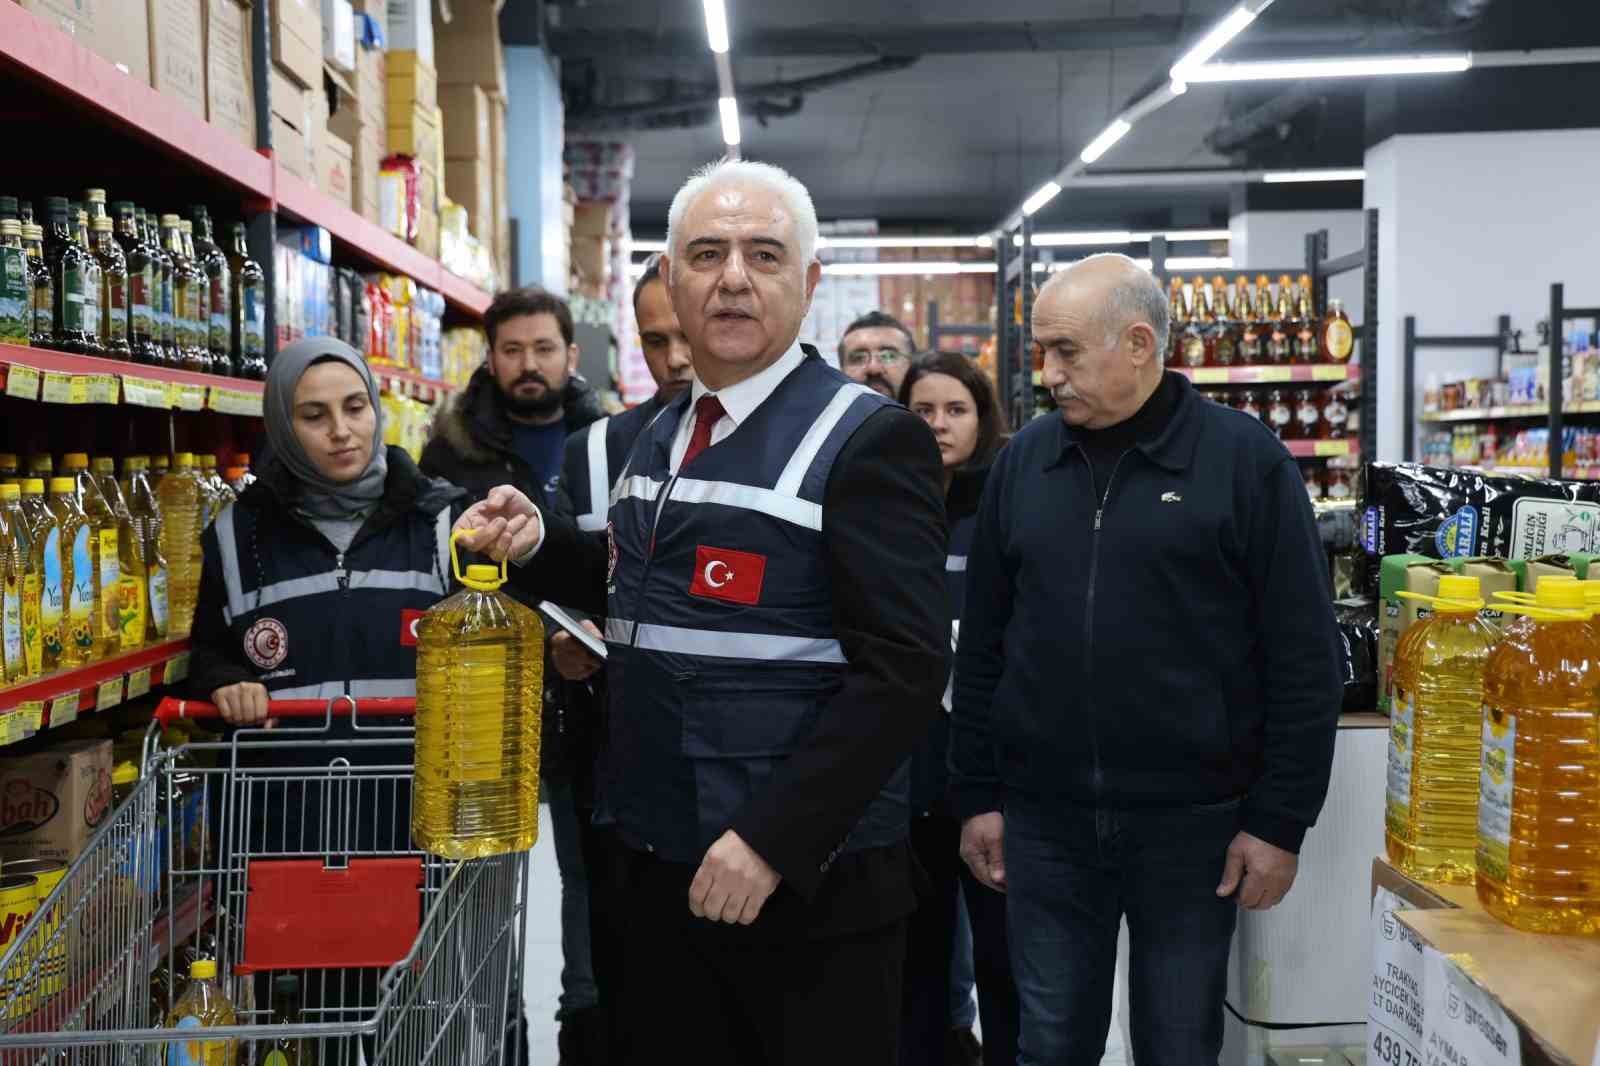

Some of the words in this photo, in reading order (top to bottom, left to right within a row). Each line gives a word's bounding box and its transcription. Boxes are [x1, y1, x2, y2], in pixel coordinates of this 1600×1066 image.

[1458, 511, 1473, 558] ARALİ
[0, 911, 34, 946] Vi
[1373, 991, 1384, 1009] LT
[1385, 999, 1404, 1021] DAR
